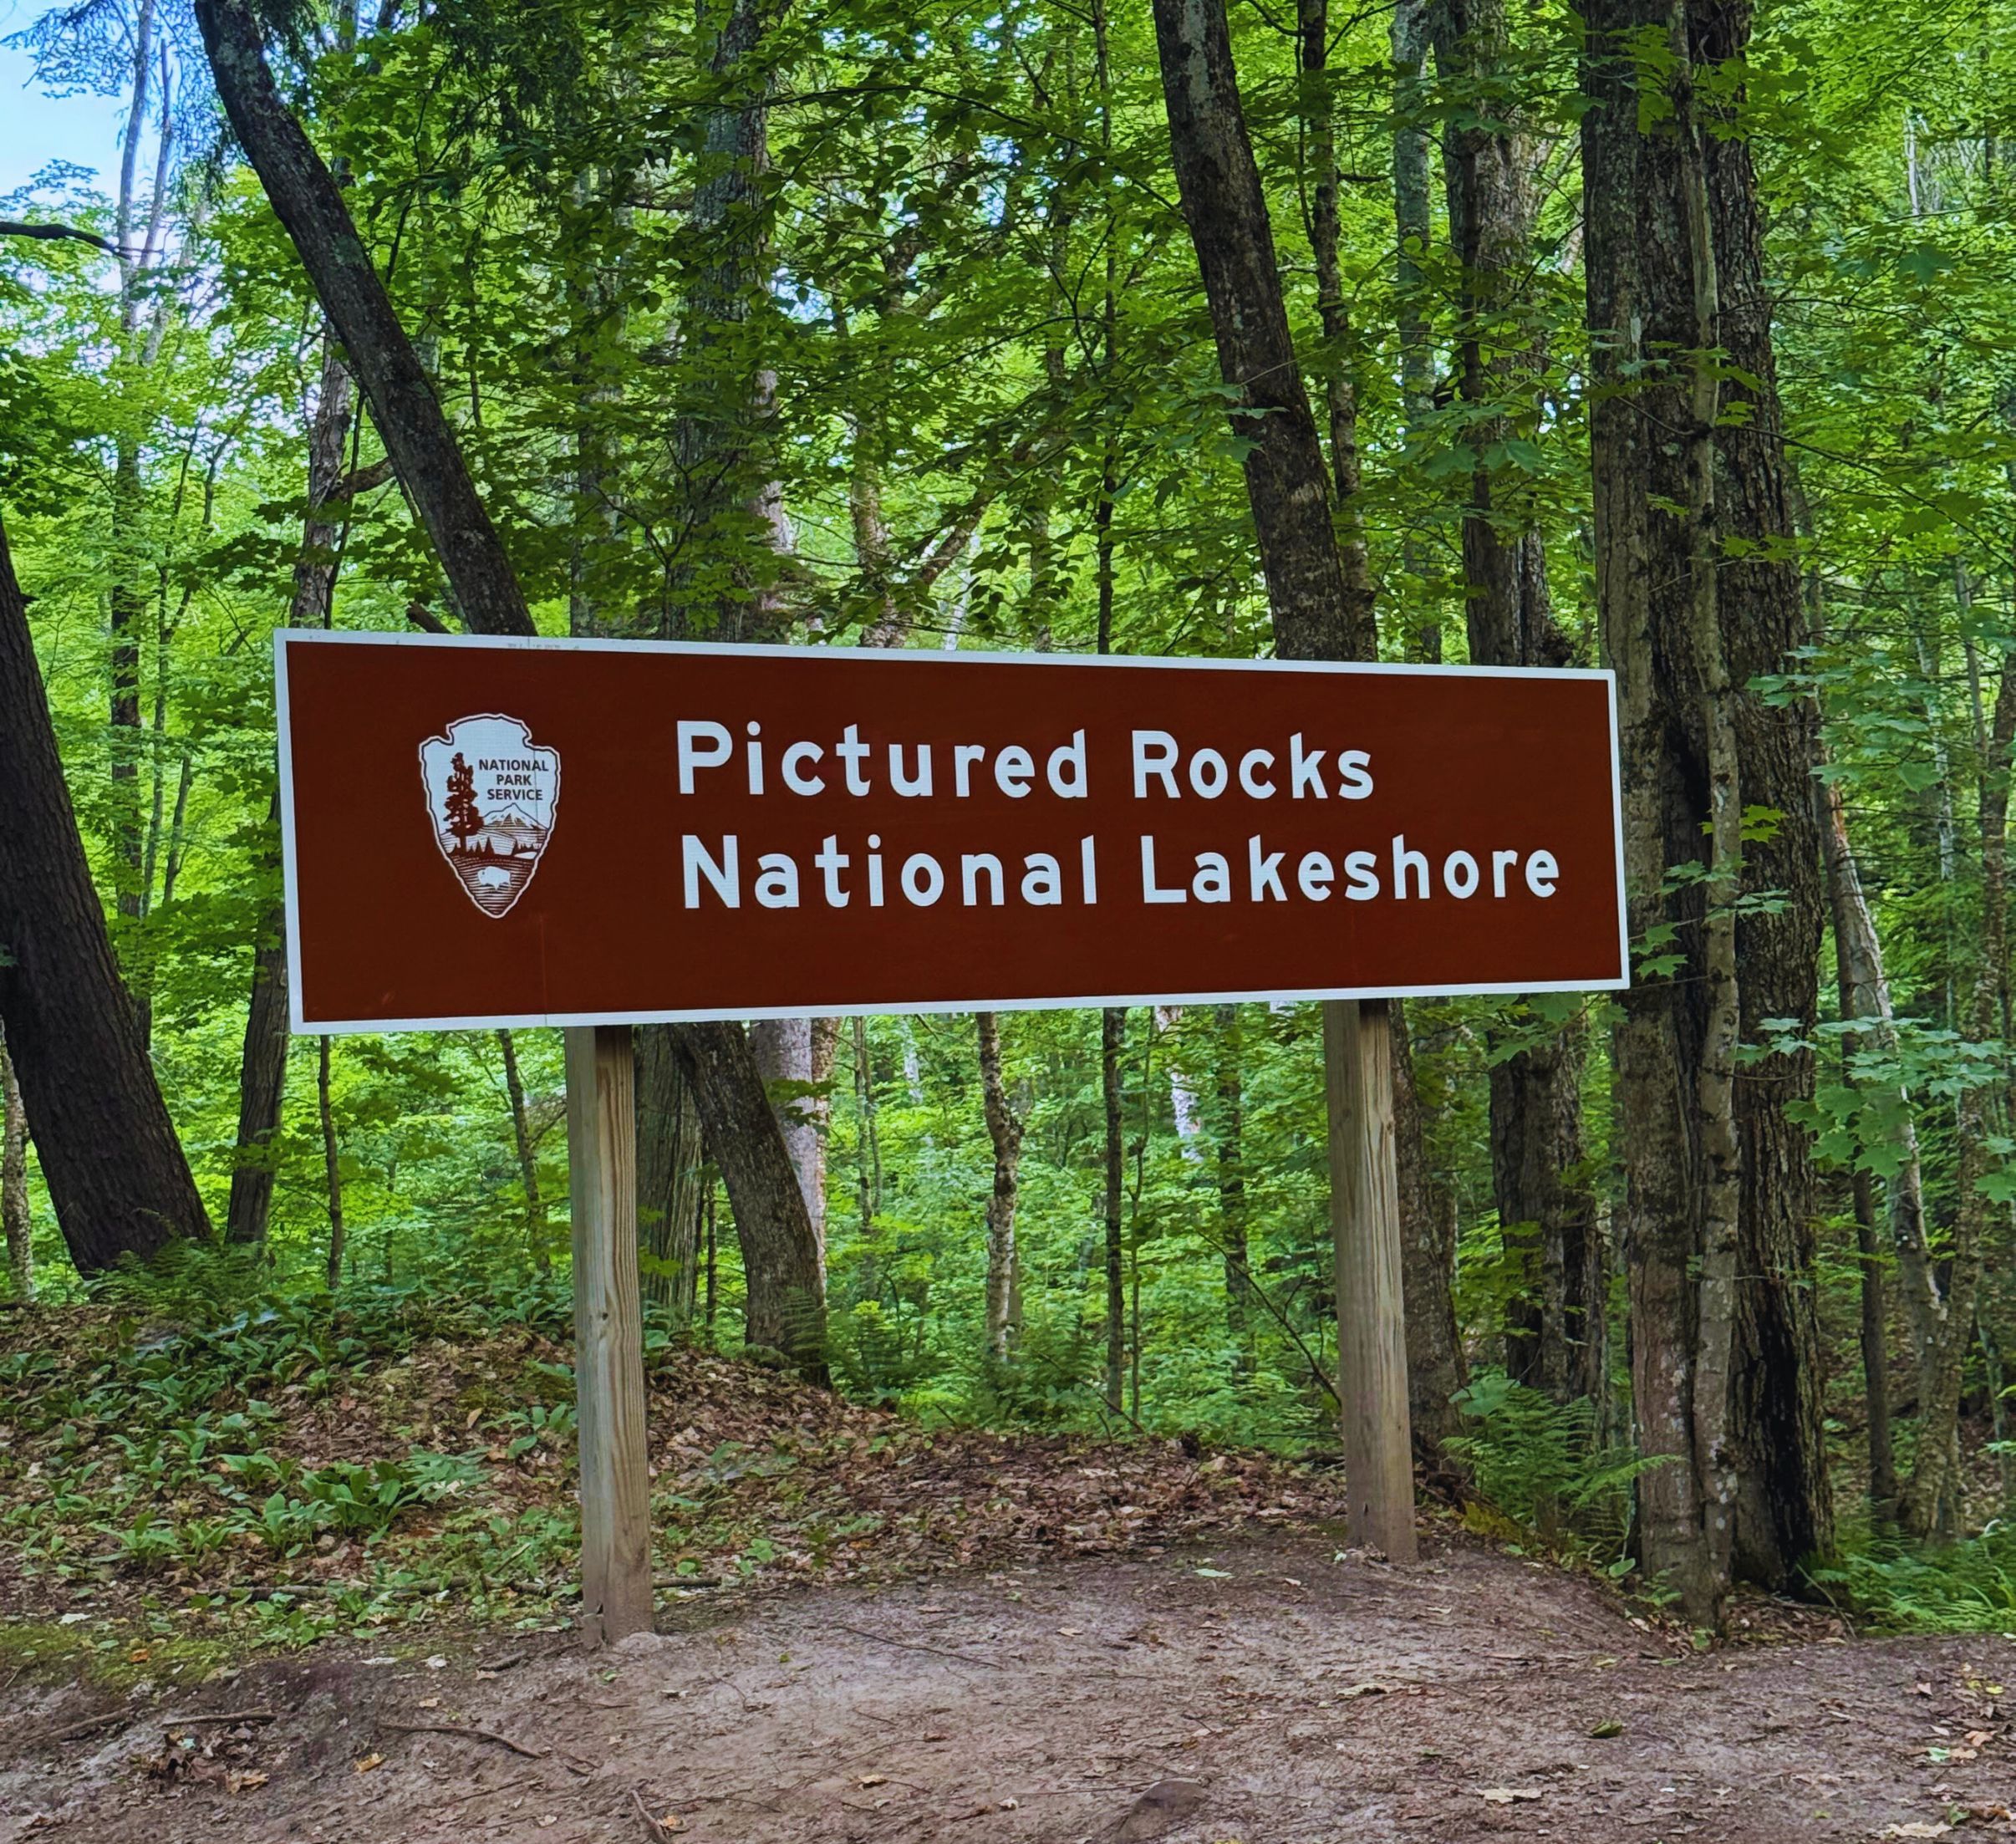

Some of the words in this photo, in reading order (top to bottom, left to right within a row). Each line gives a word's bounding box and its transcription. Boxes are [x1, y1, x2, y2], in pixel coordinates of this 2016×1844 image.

[478, 759, 549, 772] NATIONAL
[677, 721, 1087, 798] Pictured
[1133, 730, 1374, 799] Rocks
[496, 774, 532, 786] PARK
[487, 788, 543, 800] SERVICE
[683, 833, 1097, 909] National
[1141, 833, 1560, 904] Lakeshore
